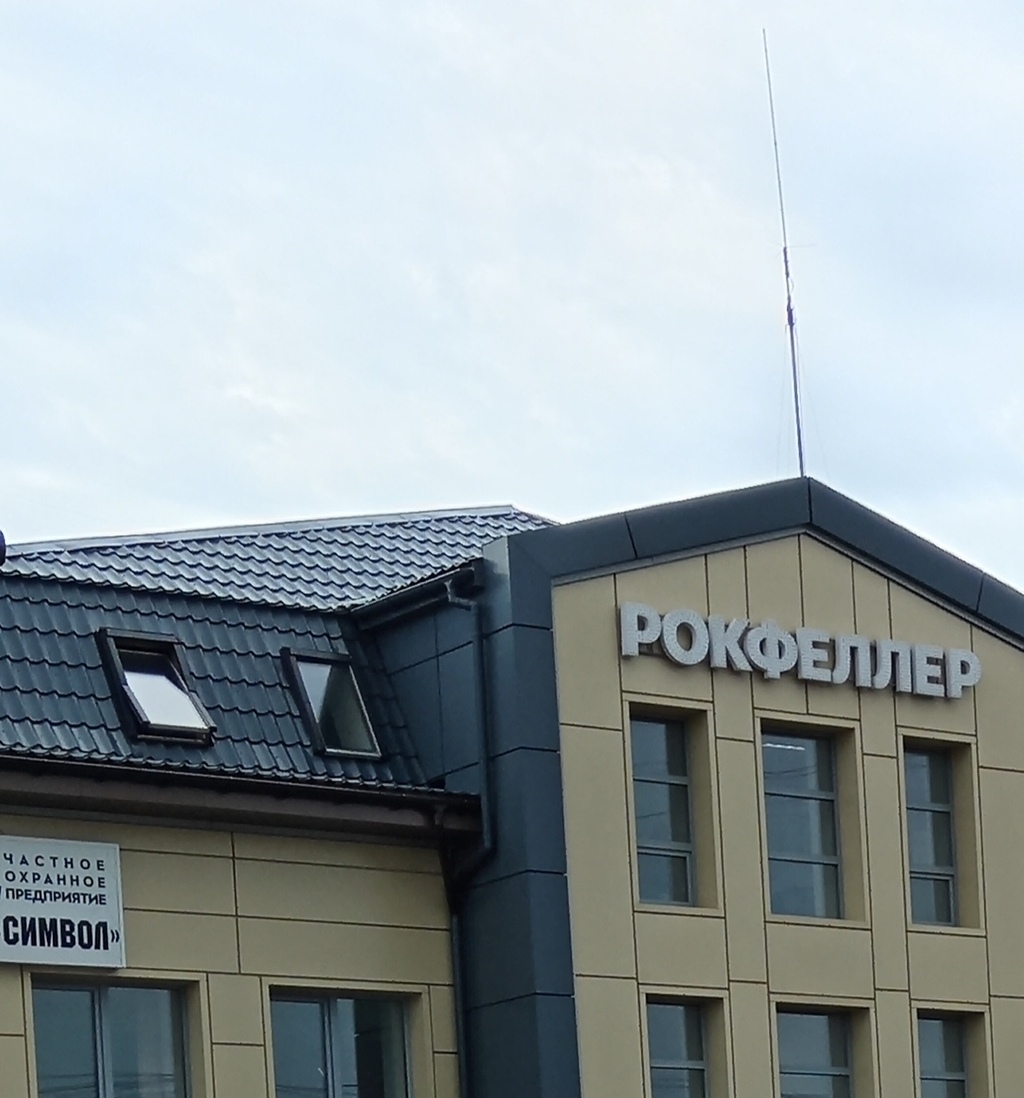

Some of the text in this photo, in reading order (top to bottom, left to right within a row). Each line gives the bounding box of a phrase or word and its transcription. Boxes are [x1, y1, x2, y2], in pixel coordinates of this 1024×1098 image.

[619, 602, 982, 699] РОКФЕЛЛЕР
[3, 853, 105, 871] ЧАСТНОЕ
[5, 870, 106, 888] ОХРАННОЕ
[5, 887, 107, 905] ПРЕДПРИЯТИЕ
[0, 915, 120, 950] СИМВОЛ»
